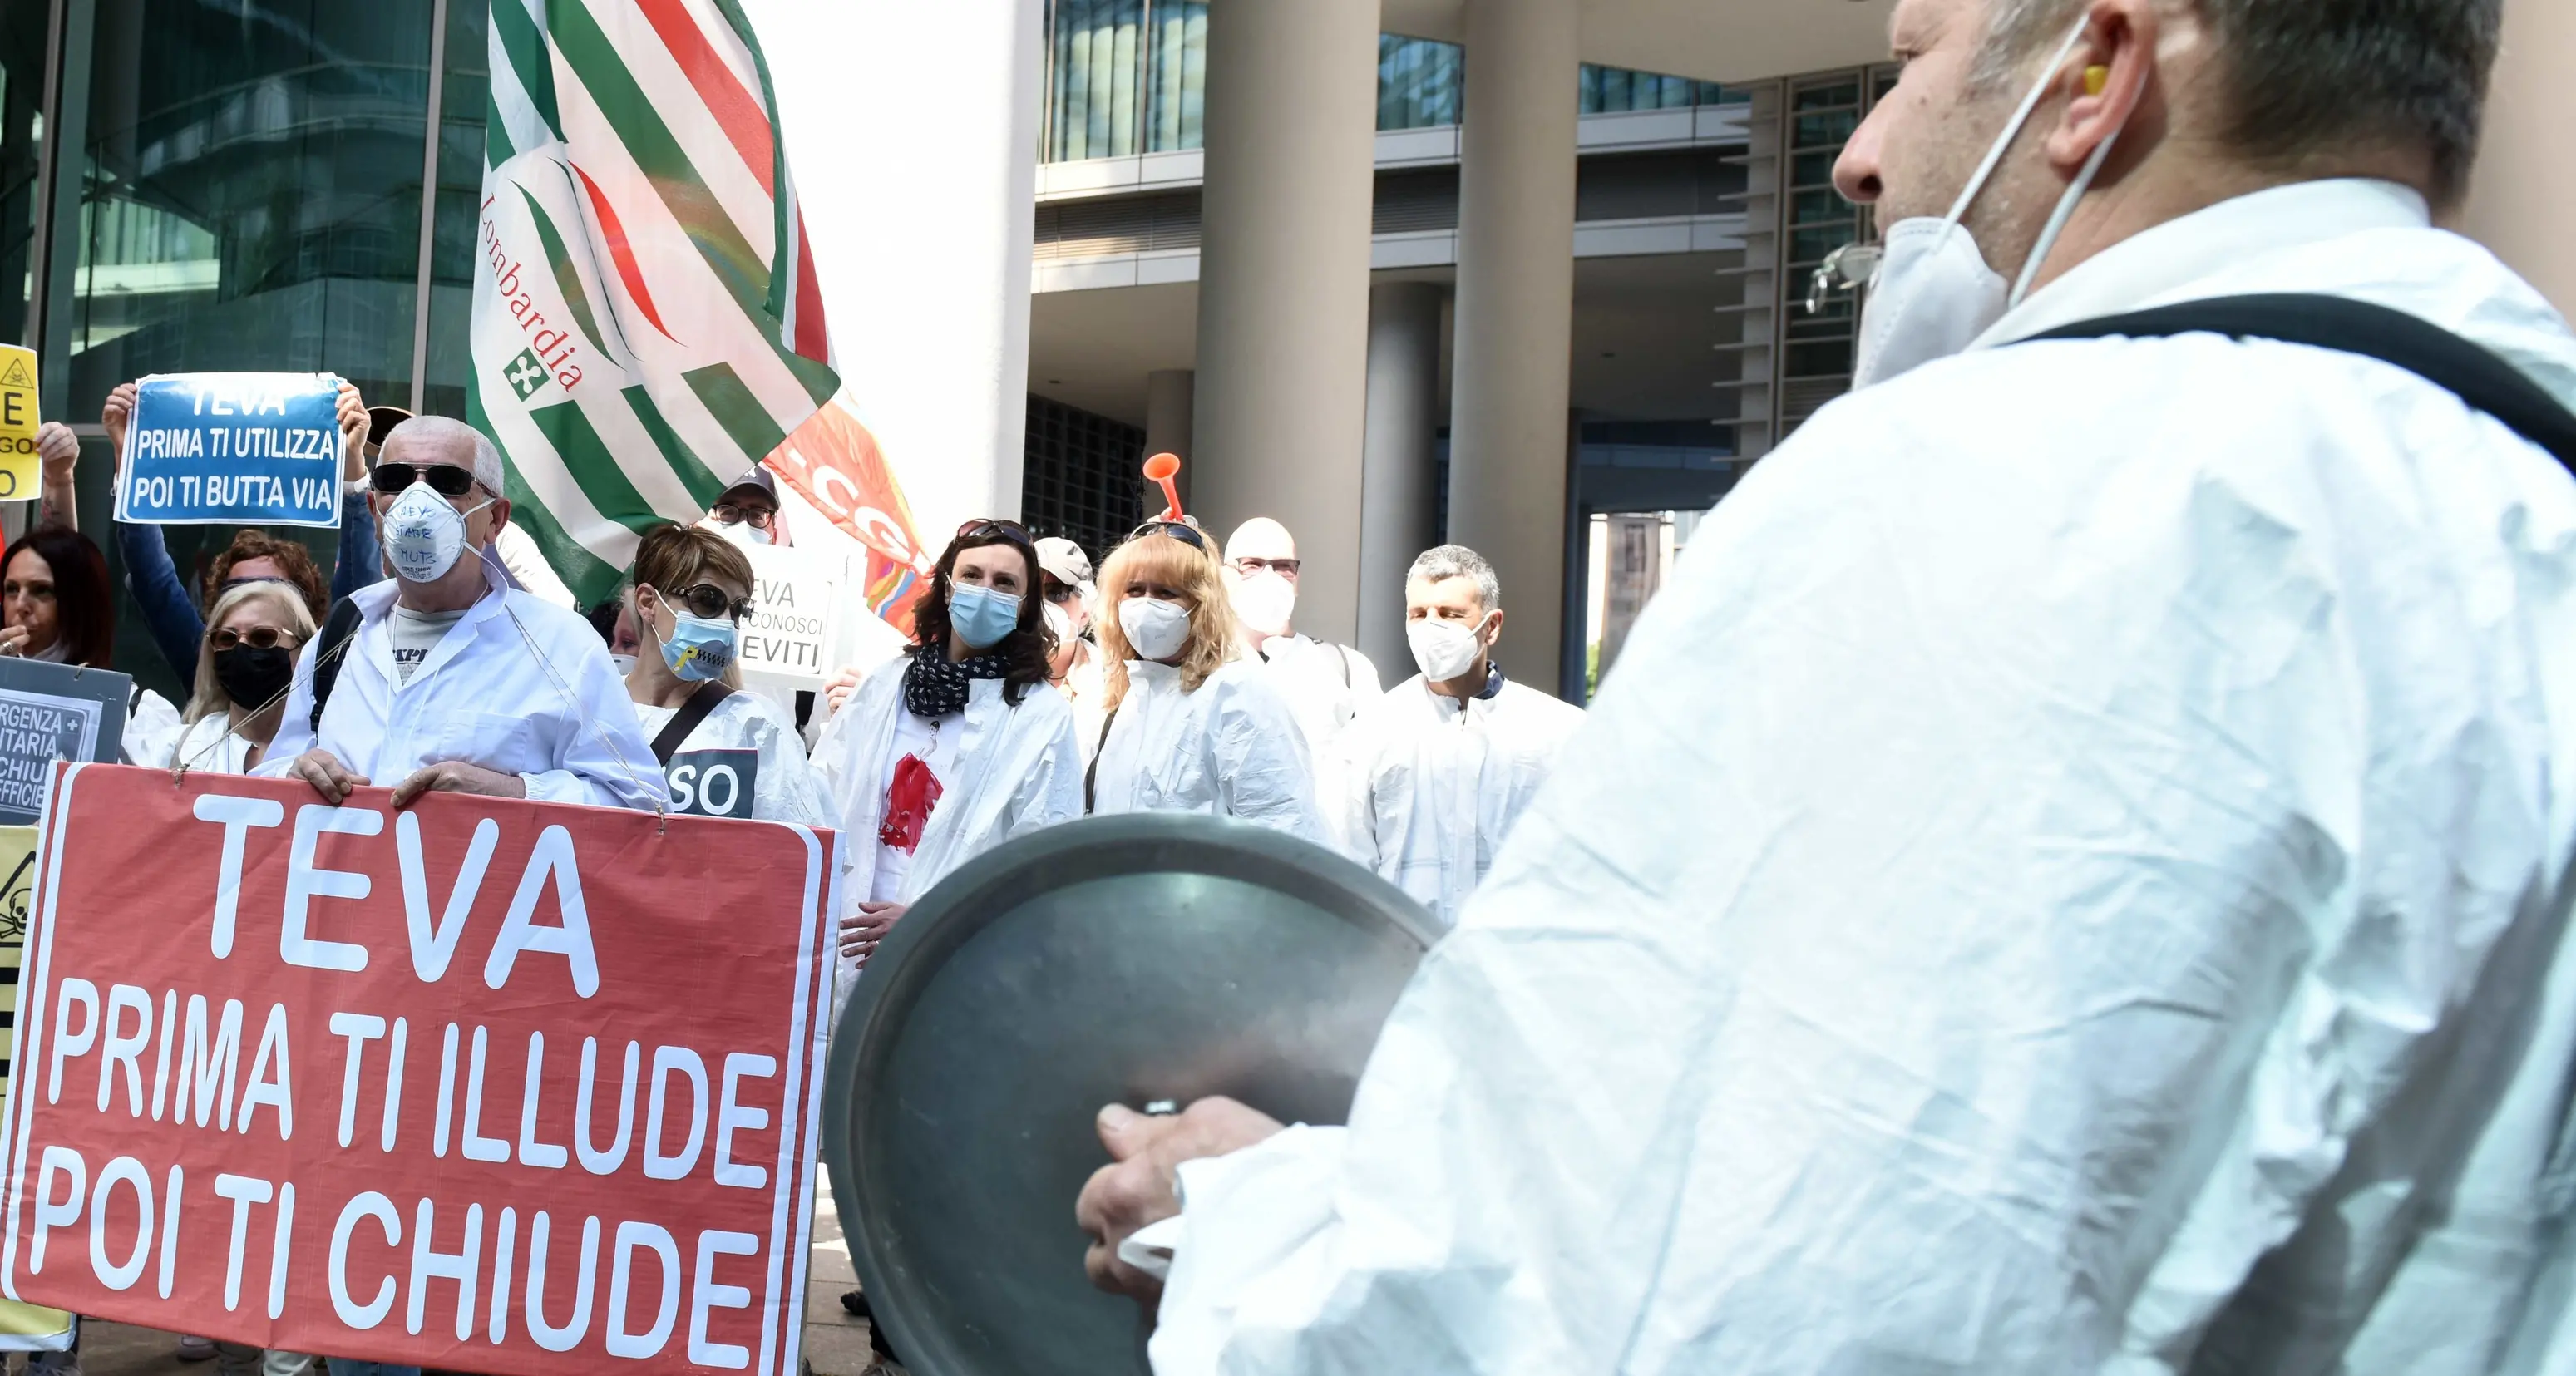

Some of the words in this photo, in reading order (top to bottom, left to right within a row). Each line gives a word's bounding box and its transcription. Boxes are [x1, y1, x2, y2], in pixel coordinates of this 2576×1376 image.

[481, 192, 583, 393] Lombardia
[192, 382, 286, 416] TEVA
[137, 428, 204, 460] PRIMA
[210, 427, 229, 458] TI
[234, 427, 334, 461] UTILIZZA
[133, 476, 174, 508] POI
[179, 476, 200, 507] TI
[205, 475, 285, 508] BUTTA
[292, 477, 333, 510] VIA
[742, 635, 819, 668] EVITI
[662, 764, 739, 816] SO
[192, 793, 600, 999] TEVA
[47, 977, 293, 1142] PRIMA
[328, 1011, 407, 1153] TI
[433, 1022, 777, 1189] ILLUDE
[29, 1145, 184, 1300] POI
[214, 1172, 295, 1320] TI
[328, 1191, 759, 1369] CHIUDE
